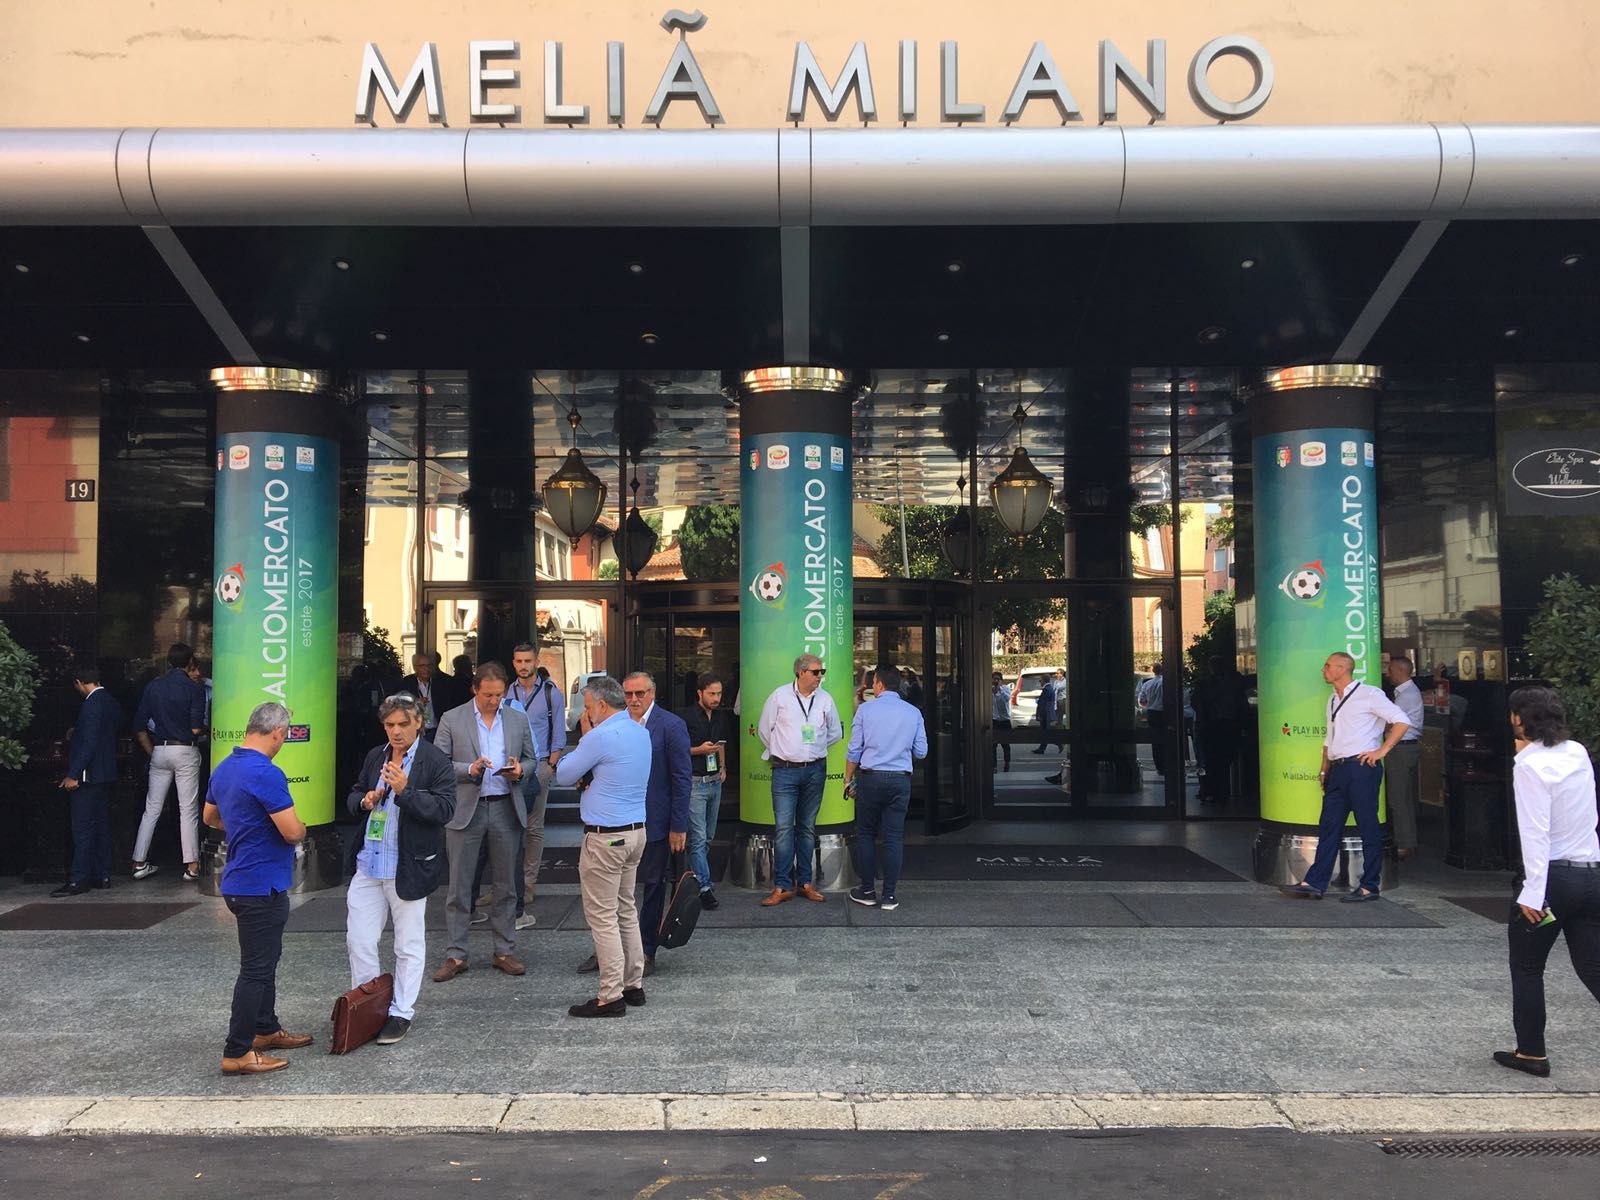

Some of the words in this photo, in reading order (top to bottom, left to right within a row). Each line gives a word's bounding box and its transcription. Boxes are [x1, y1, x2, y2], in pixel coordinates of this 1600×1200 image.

[786, 35, 1275, 122] MILANO
[70, 482, 89, 498] 19
[262, 478, 290, 708] ALCIOMERCATO
[298, 558, 313, 599] 2017
[833, 556, 844, 598] 2017
[1341, 475, 1367, 684] LCIOMERCATO
[1369, 554, 1377, 595] 2017
[300, 605, 312, 647] estate
[836, 603, 844, 646] estate
[1293, 726, 1310, 735] PLAY
[1312, 726, 1320, 735] IN
[287, 776, 310, 784] scout
